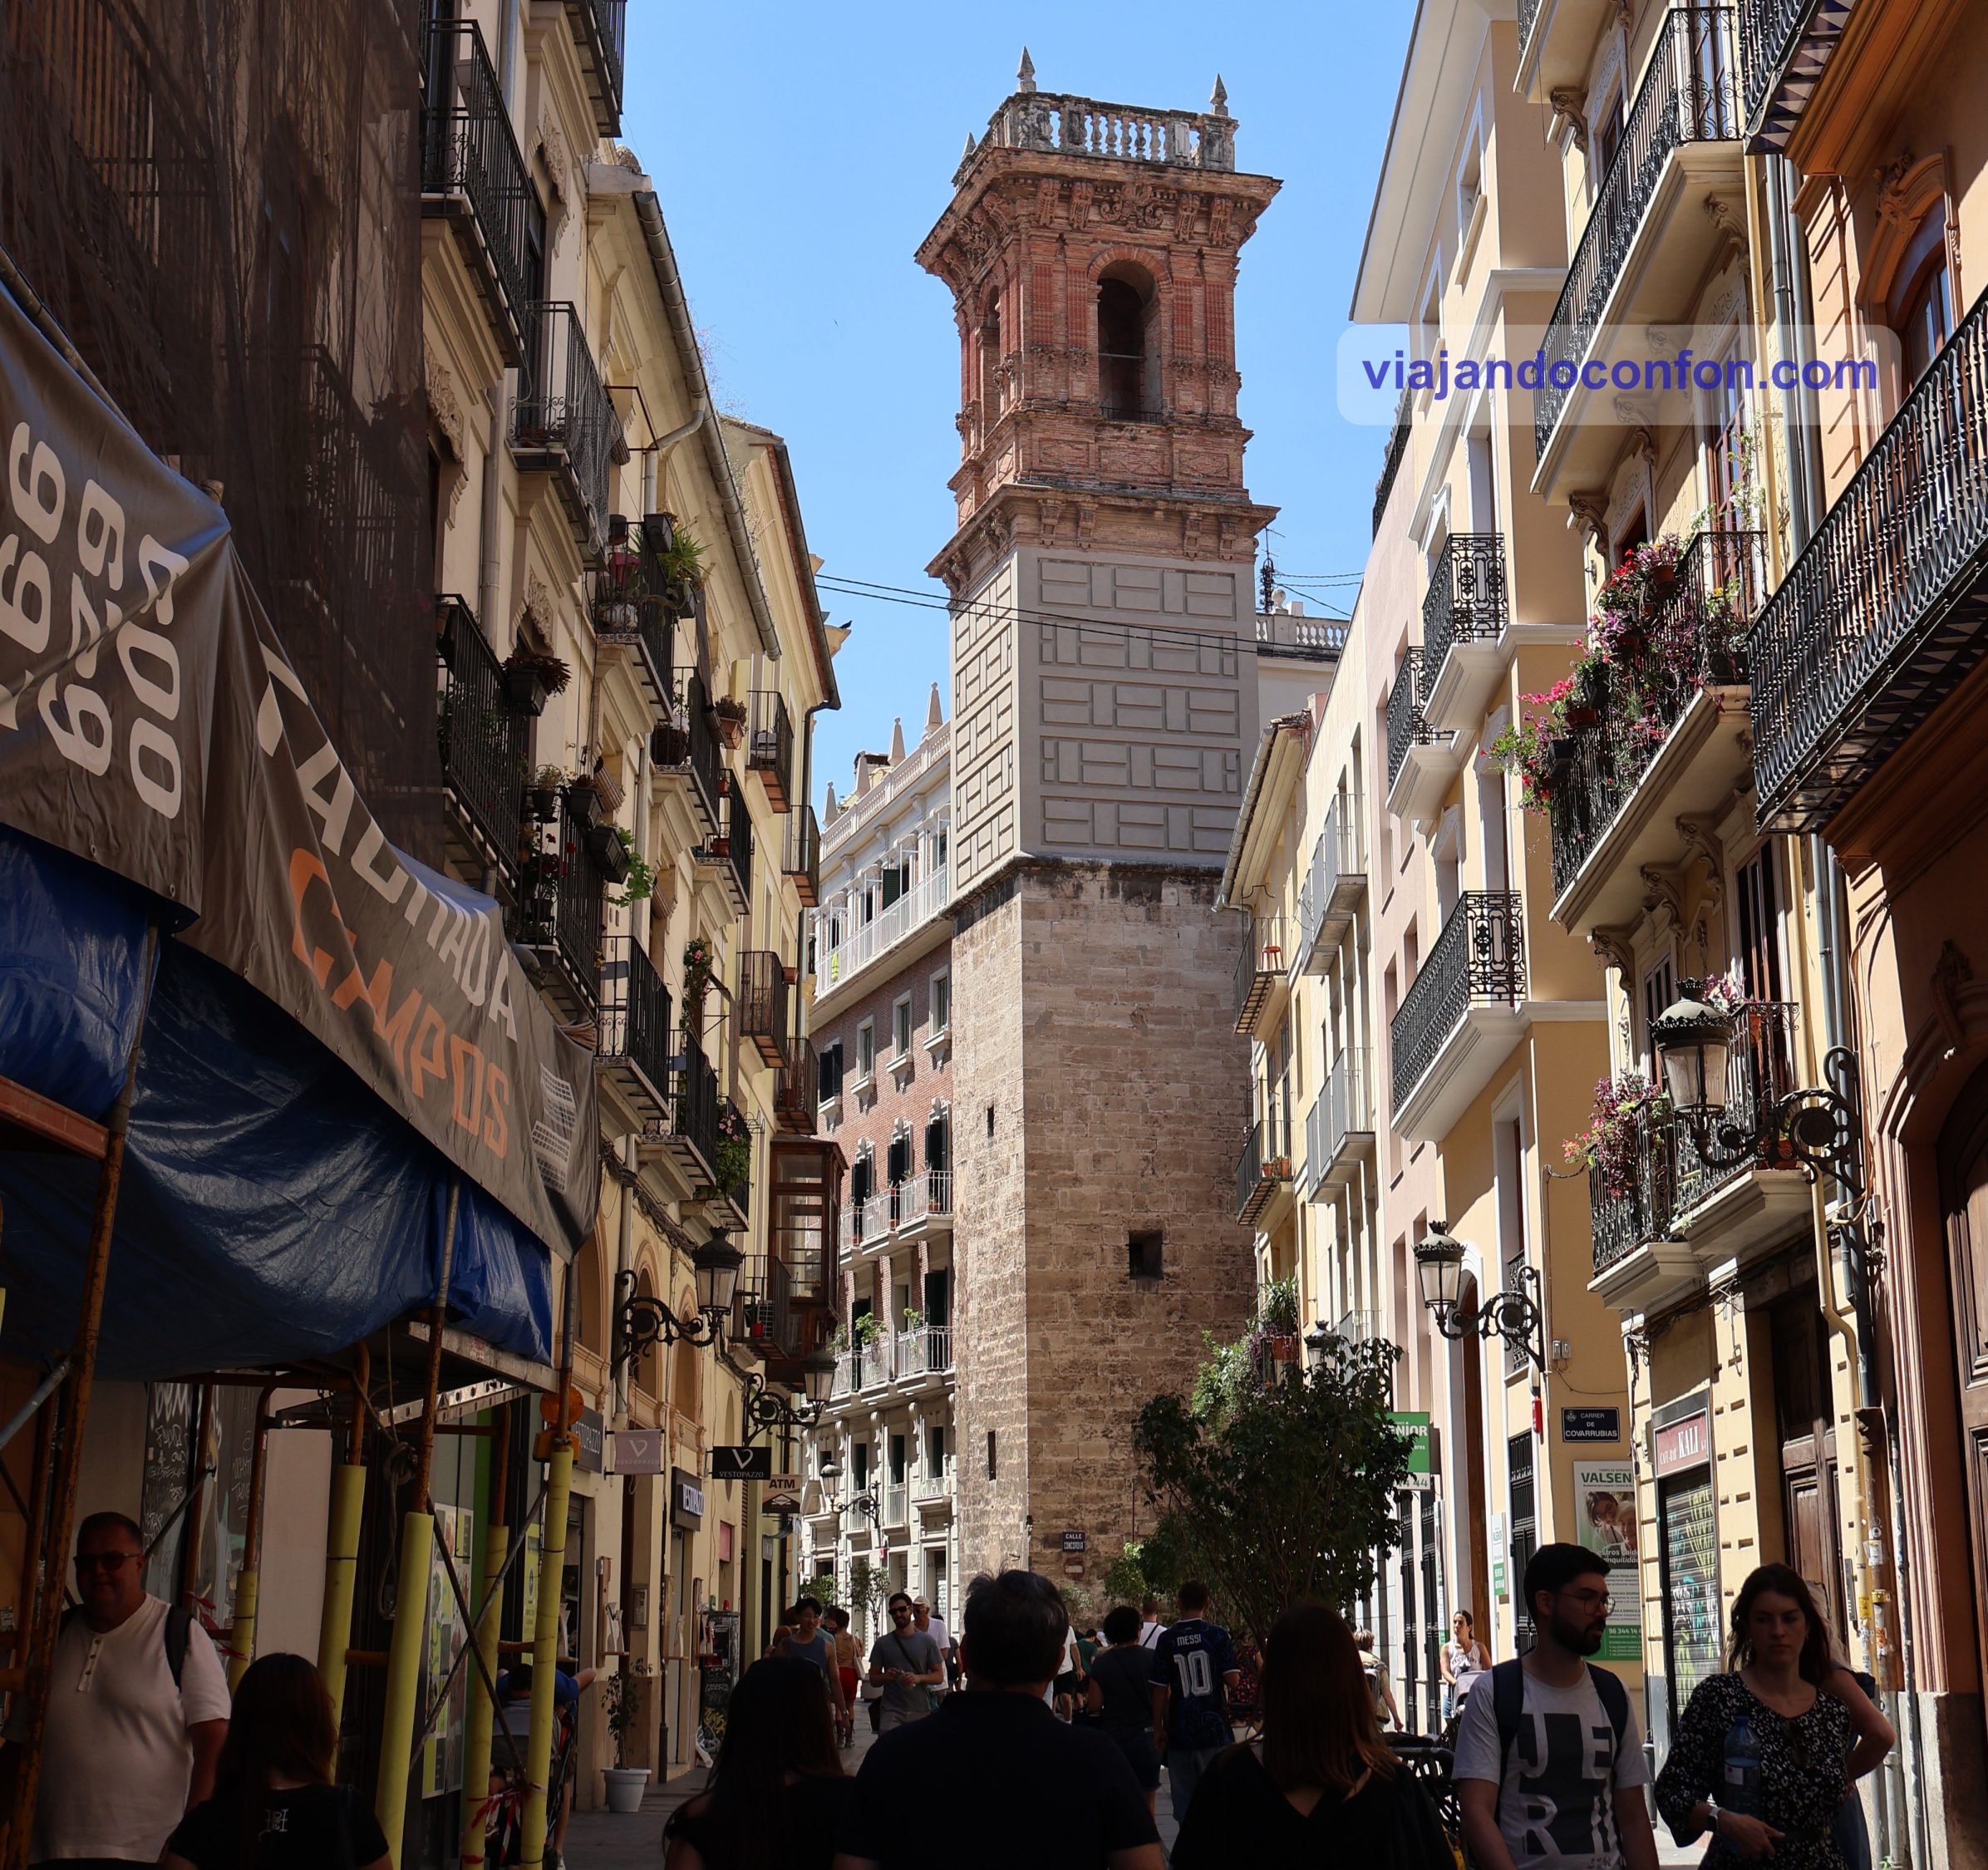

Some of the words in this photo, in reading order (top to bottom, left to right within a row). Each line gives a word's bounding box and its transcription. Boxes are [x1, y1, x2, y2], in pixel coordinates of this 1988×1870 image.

[288, 847, 510, 1159] CAMPOS
[1677, 1425, 1700, 1459] KALI
[682, 1484, 705, 1517] VESTOPAZZO
[769, 1479, 796, 1489] ATM
[1176, 1633, 1203, 1646] MESSI
[1173, 1649, 1213, 1700] 10
